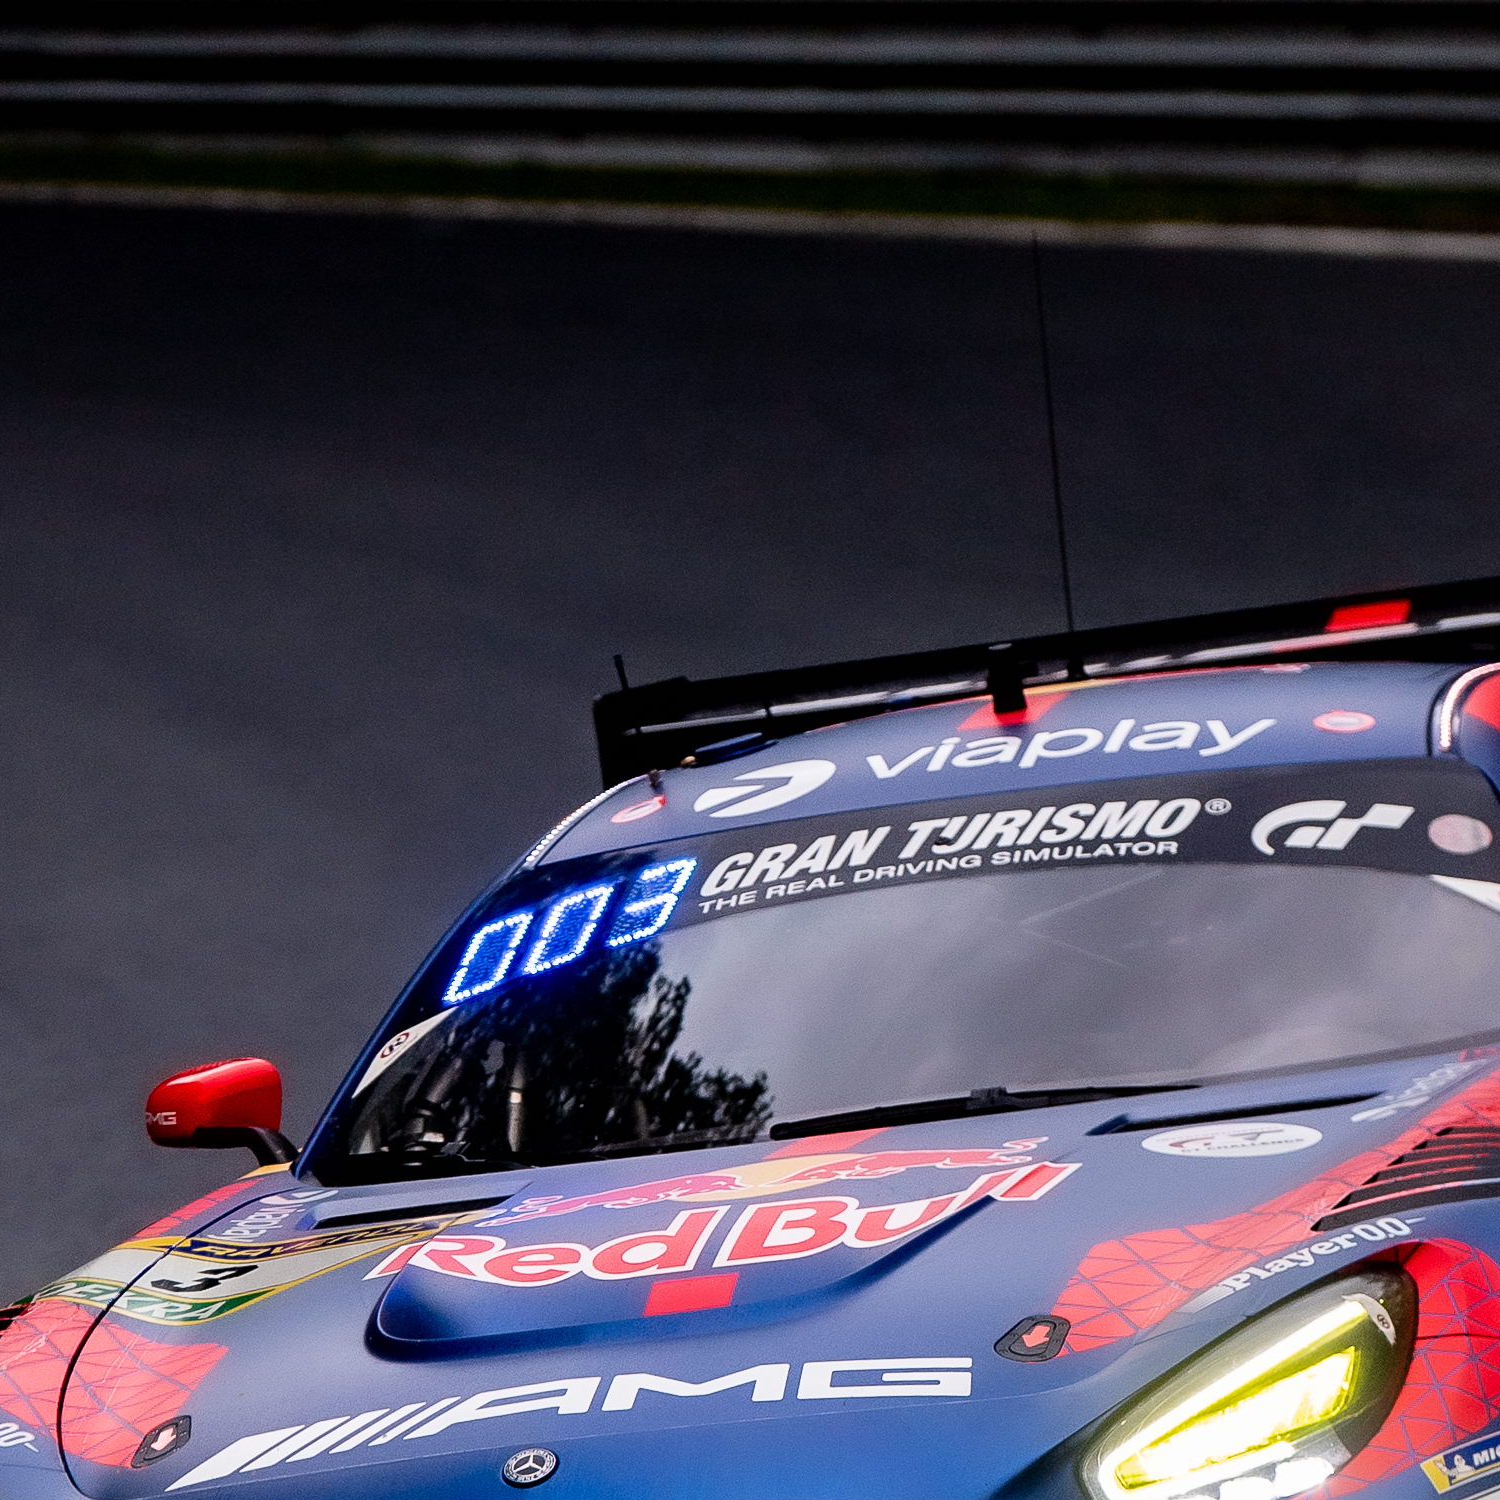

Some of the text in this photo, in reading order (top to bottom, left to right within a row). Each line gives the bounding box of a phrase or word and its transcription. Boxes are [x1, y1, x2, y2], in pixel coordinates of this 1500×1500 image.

[865, 718, 1277, 780] viaplay
[698, 840, 1179, 914] THE REAL DRIVING SIMULATOR
[699, 825, 892, 897] GRAN
[363, 1162, 1083, 1288] Red Bull
[45, 1280, 229, 1321] DEKRA
[150, 1264, 259, 1293] 3
[404, 1357, 973, 1441] AMG
